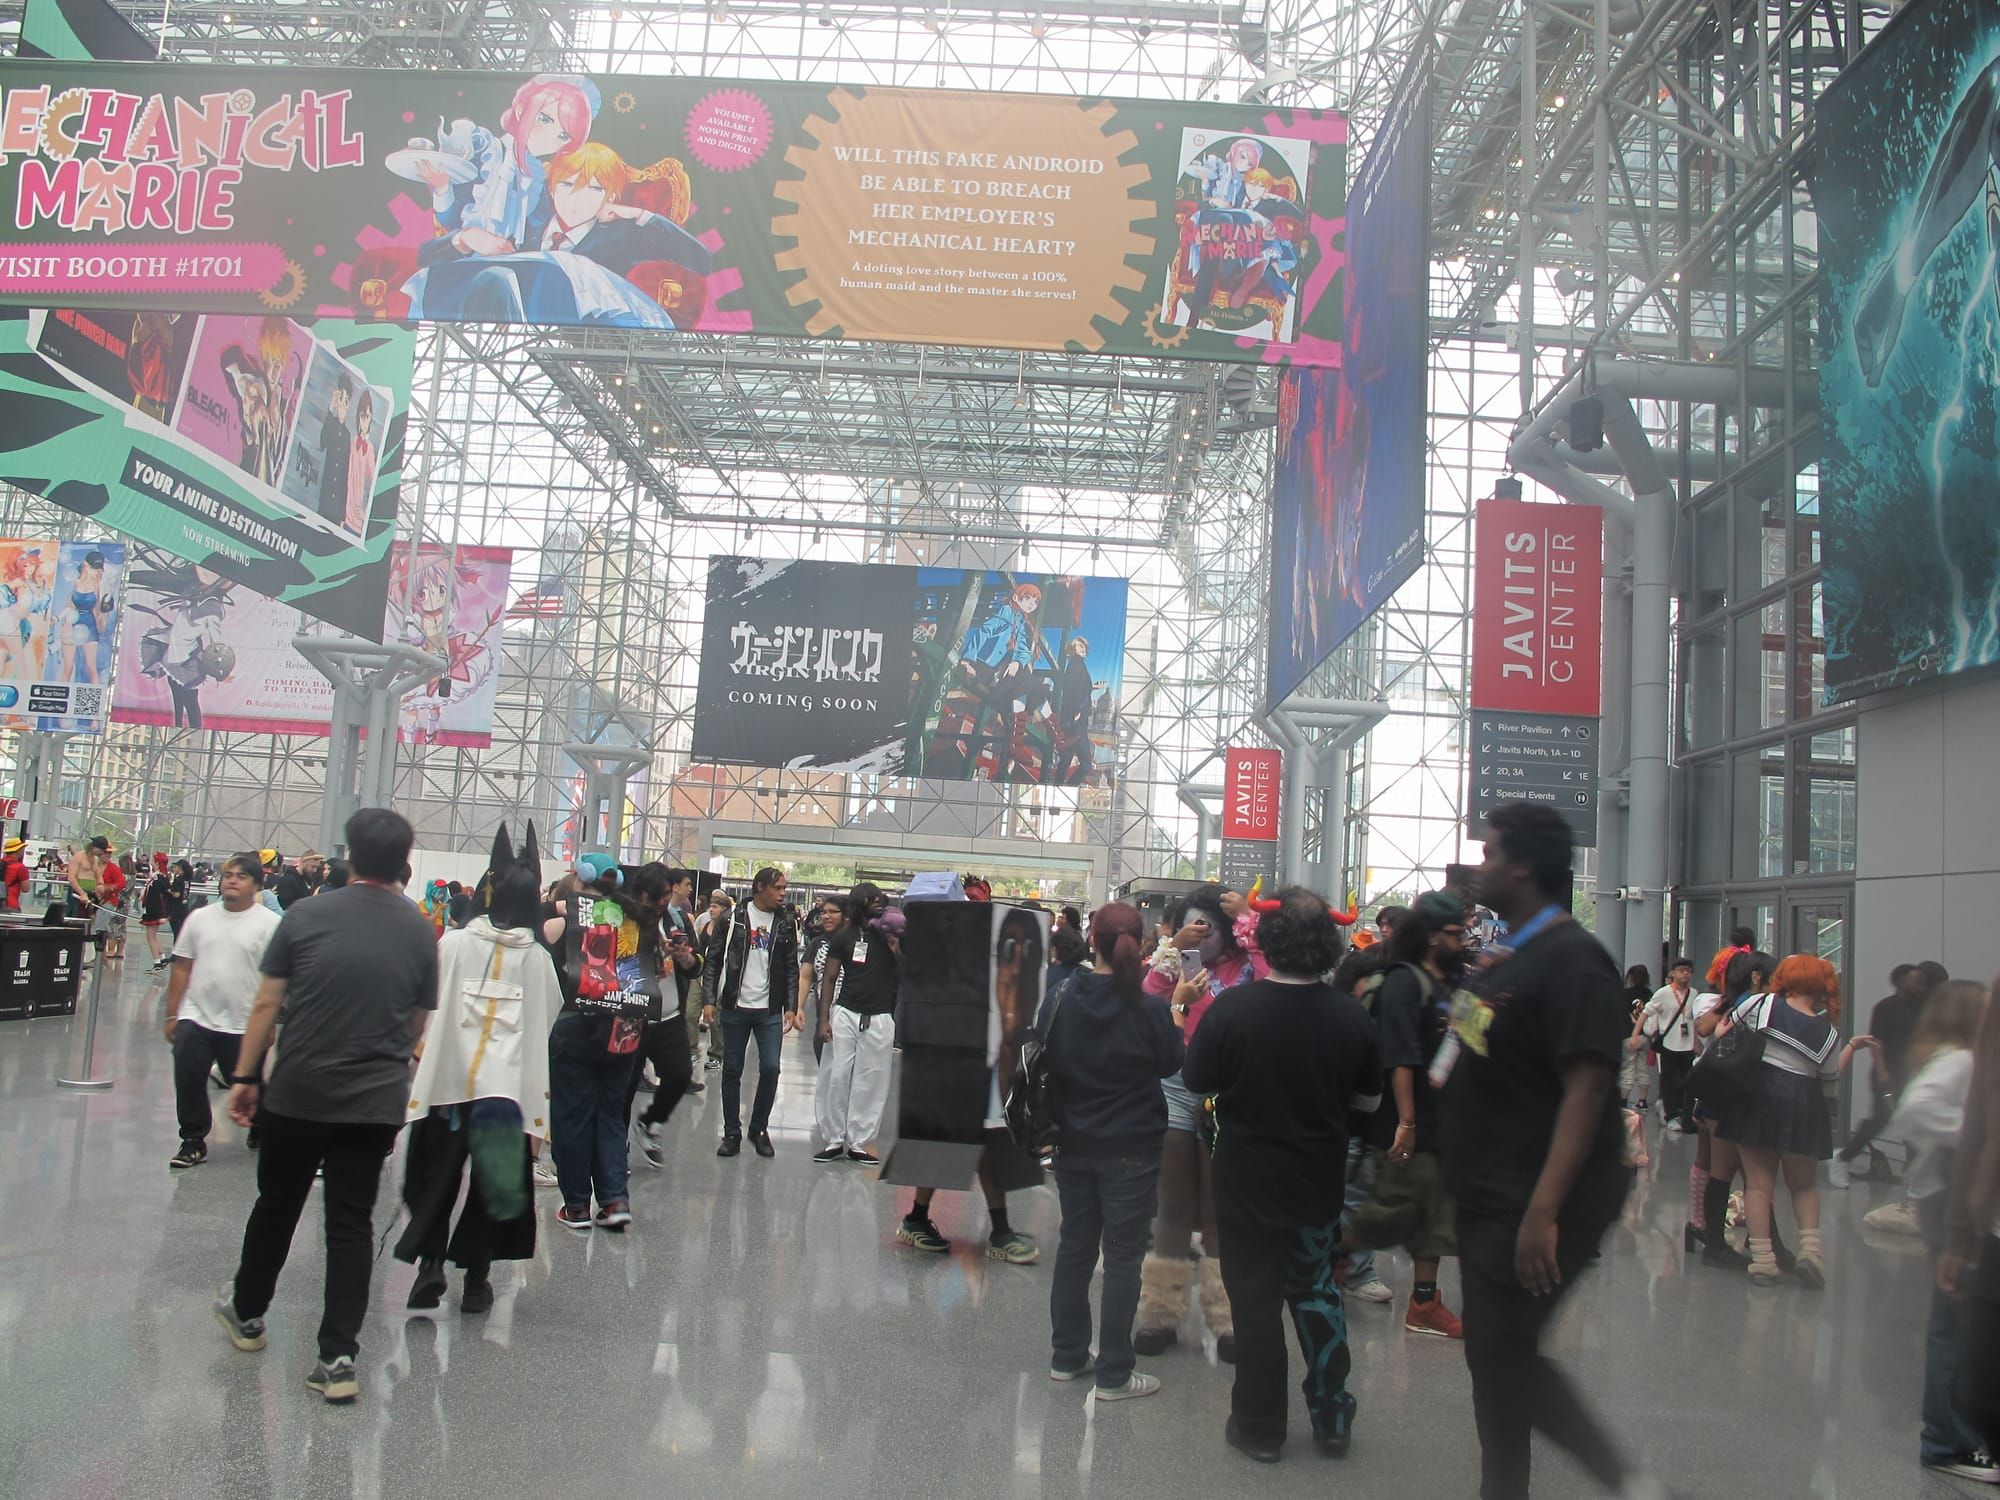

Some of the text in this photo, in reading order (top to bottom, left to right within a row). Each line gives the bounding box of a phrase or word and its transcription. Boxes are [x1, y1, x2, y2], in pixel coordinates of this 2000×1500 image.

[706, 116, 754, 133] AVAILABLE
[714, 106, 750, 122] VOLUME
[0, 84, 363, 170] ECHANICAL
[697, 135, 753, 155] AND DIGITAL
[731, 132, 759, 145] PRINT
[833, 147, 1104, 175] WILL THIS FAKE ANDROID
[15, 157, 242, 235] MARIE
[860, 176, 1071, 200] BE ABLE TO BREACH
[872, 203, 1054, 228] HER EMPLOYER'S
[848, 230, 1075, 257] MECHANICAL HEART?
[68, 256, 167, 278] BOOTH
[175, 255, 242, 278] #1701
[852, 262, 861, 272] A
[864, 263, 900, 278] doting
[905, 264, 930, 276] love
[935, 267, 964, 281] story
[968, 267, 1018, 280] between
[1032, 270, 1066, 283] 100%
[840, 277, 881, 289] human
[886, 279, 915, 291] maid
[919, 280, 941, 292] and
[944, 283, 964, 294] the
[967, 285, 1008, 297] master
[1012, 286, 1031, 298] she
[188, 385, 228, 424] BLEACH
[133, 459, 298, 559] YOUR ANIME DESTINATION
[182, 525, 250, 567] NOW STREAMING
[1503, 532, 1536, 681] JAVITS
[1550, 532, 1577, 682] CENTER
[265, 679, 308, 687] COMING
[729, 663, 880, 683] VIRGIN PUNK
[729, 691, 879, 712] COMING SOON
[1498, 723, 1552, 736] River Pavilion
[1497, 745, 1521, 754] Javits
[1523, 746, 1549, 757] North,
[1551, 748, 1561, 757] 1A
[1570, 749, 1581, 758] 1D
[1497, 767, 1524, 777] 2D, 3A
[1578, 772, 1589, 781] 1E
[1236, 761, 1252, 825] JAVITS
[1256, 761, 1269, 827] CENTER
[1496, 789, 1556, 801] Special Events
[603, 990, 650, 1007] ANIME NYC
